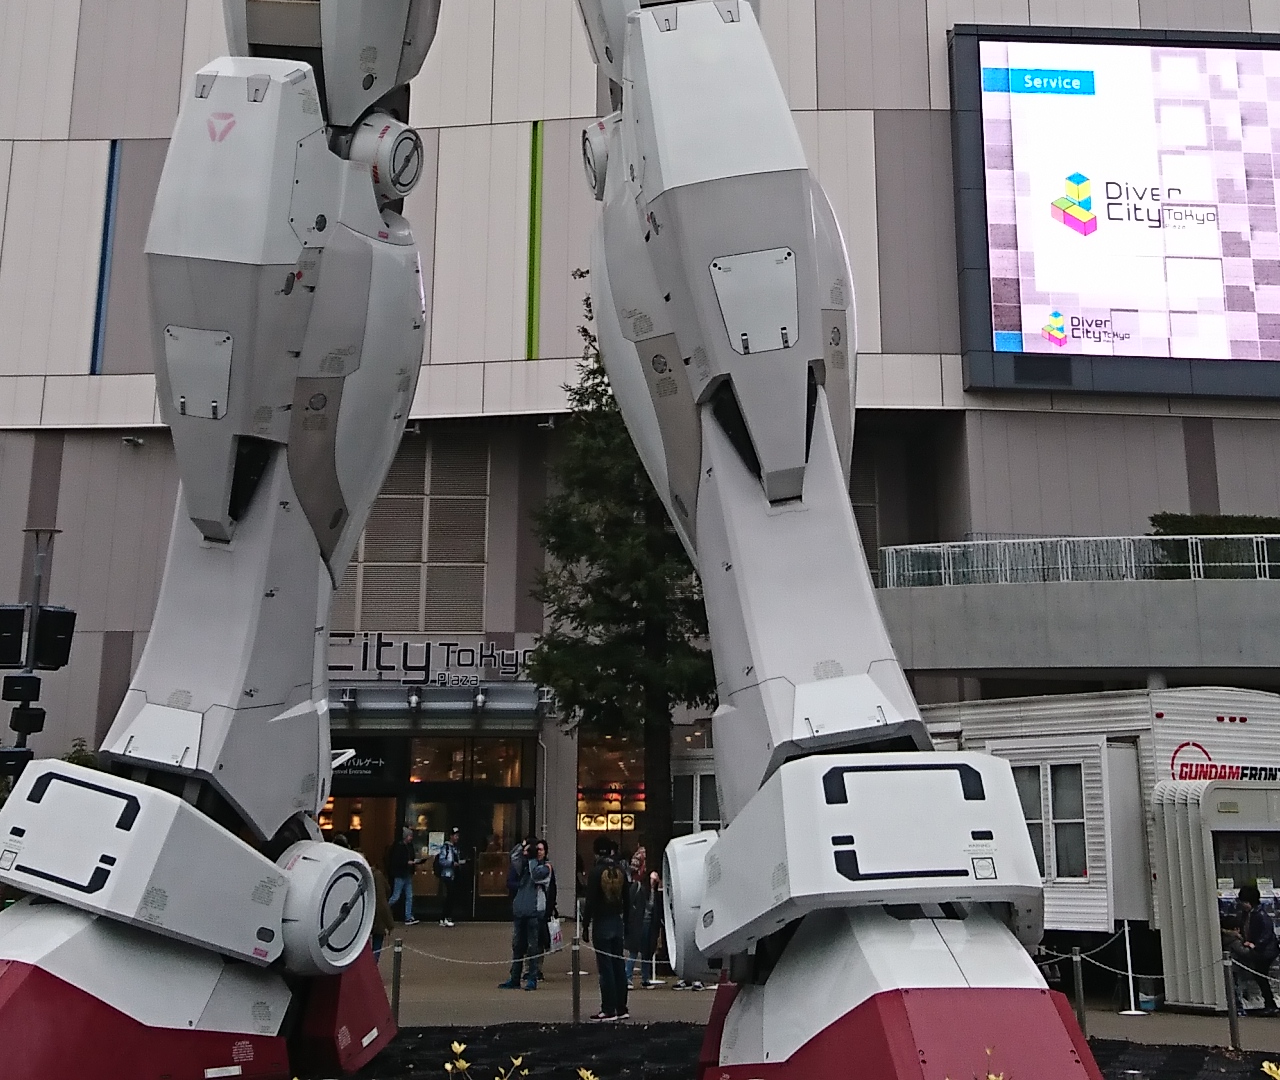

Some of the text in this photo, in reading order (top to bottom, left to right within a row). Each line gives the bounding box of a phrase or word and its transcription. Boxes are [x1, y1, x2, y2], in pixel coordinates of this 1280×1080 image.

[1023, 74, 1081, 90] Service
[1106, 202, 1162, 229] City
[1070, 316, 1111, 328] Diver
[1071, 328, 1101, 342] City
[436, 672, 480, 686] Plaza
